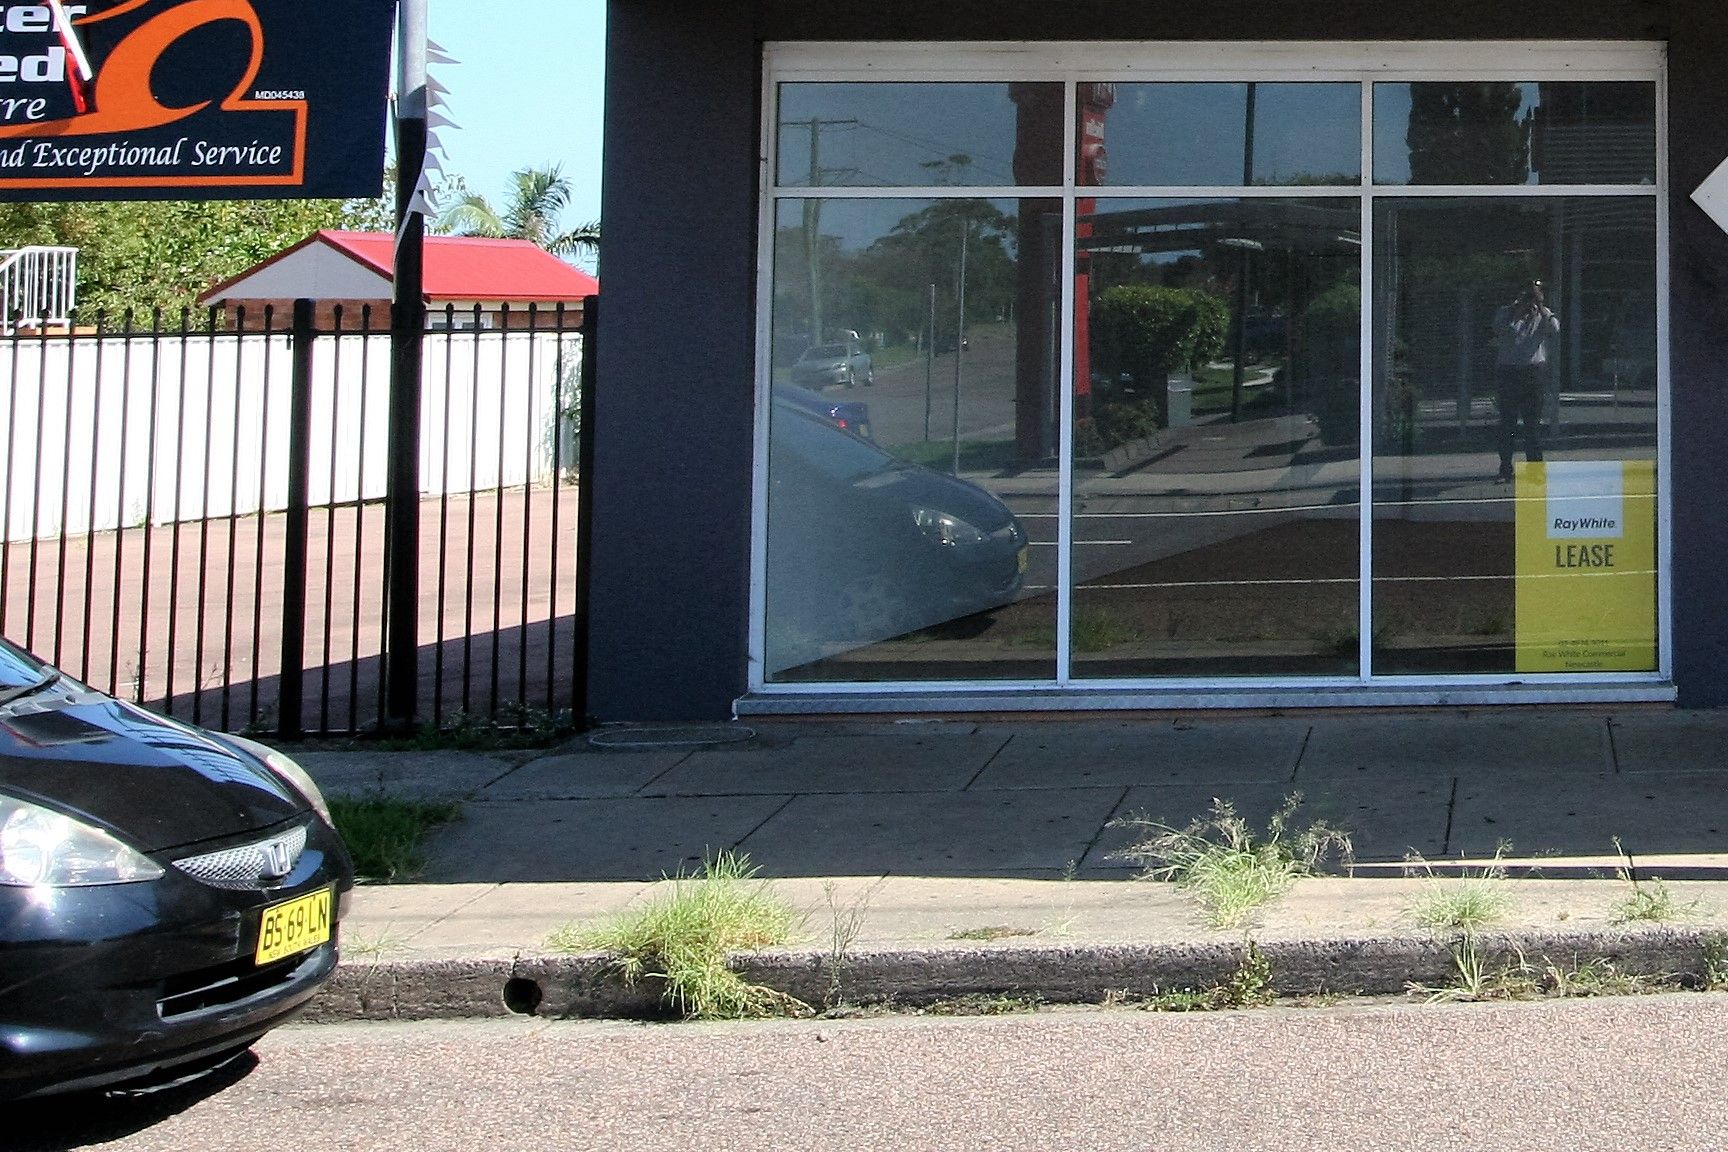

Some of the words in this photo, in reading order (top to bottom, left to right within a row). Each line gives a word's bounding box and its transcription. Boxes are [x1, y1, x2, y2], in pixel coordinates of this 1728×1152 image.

[0, 5, 87, 33] er
[0, 97, 46, 120] re
[32, 137, 188, 176] Exceptional
[191, 139, 282, 167] Service
[1556, 544, 1615, 568] LEASE
